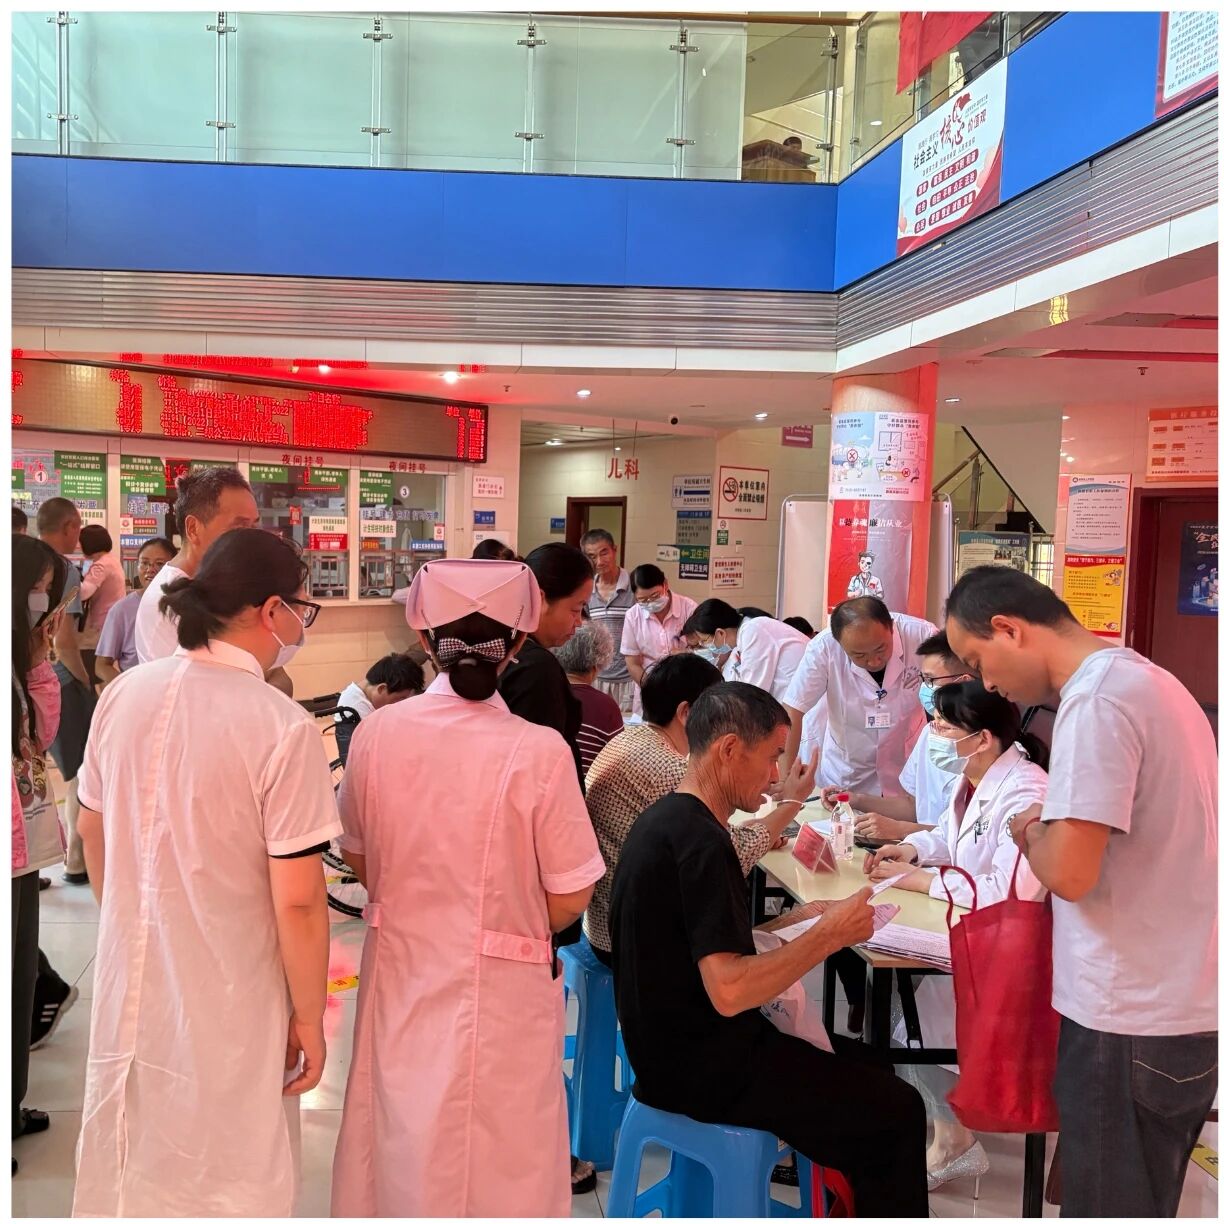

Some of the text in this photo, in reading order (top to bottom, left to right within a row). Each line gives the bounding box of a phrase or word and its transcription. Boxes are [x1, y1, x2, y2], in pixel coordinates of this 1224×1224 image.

[914, 140, 939, 169] 社会主义
[281, 454, 325, 468] 夜间挂号
[389, 461, 428, 473] 夜间挂号
[607, 458, 640, 481] 儿科
